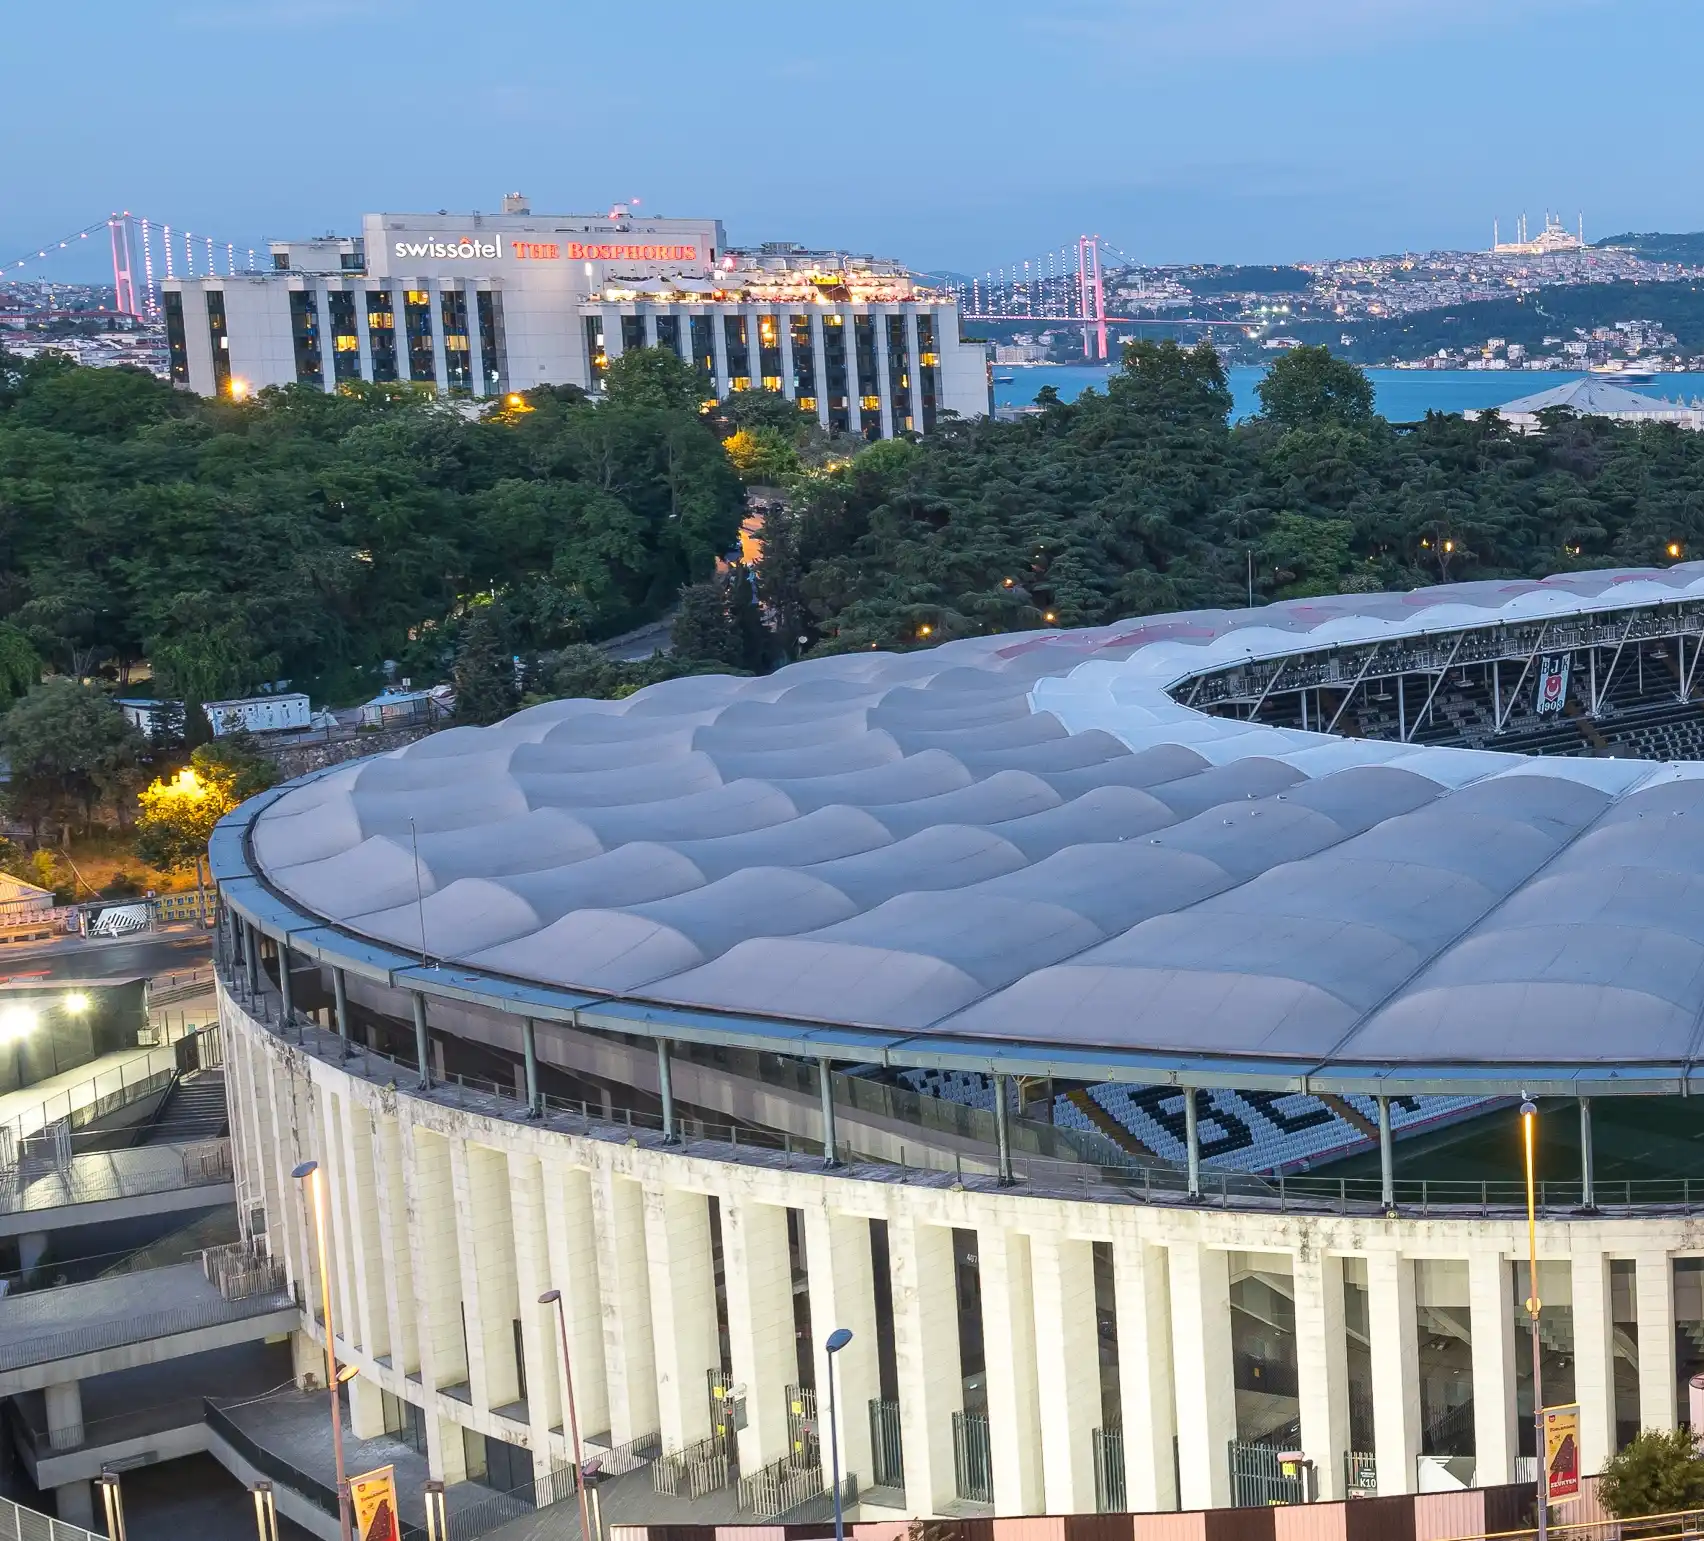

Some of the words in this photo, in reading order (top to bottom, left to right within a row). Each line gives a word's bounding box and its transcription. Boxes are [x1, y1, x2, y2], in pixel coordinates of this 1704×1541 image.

[395, 233, 502, 258] swissôtel
[512, 241, 560, 260] THE
[567, 241, 697, 260] BOSPHORUS
[1360, 1478, 1377, 1488] K10
